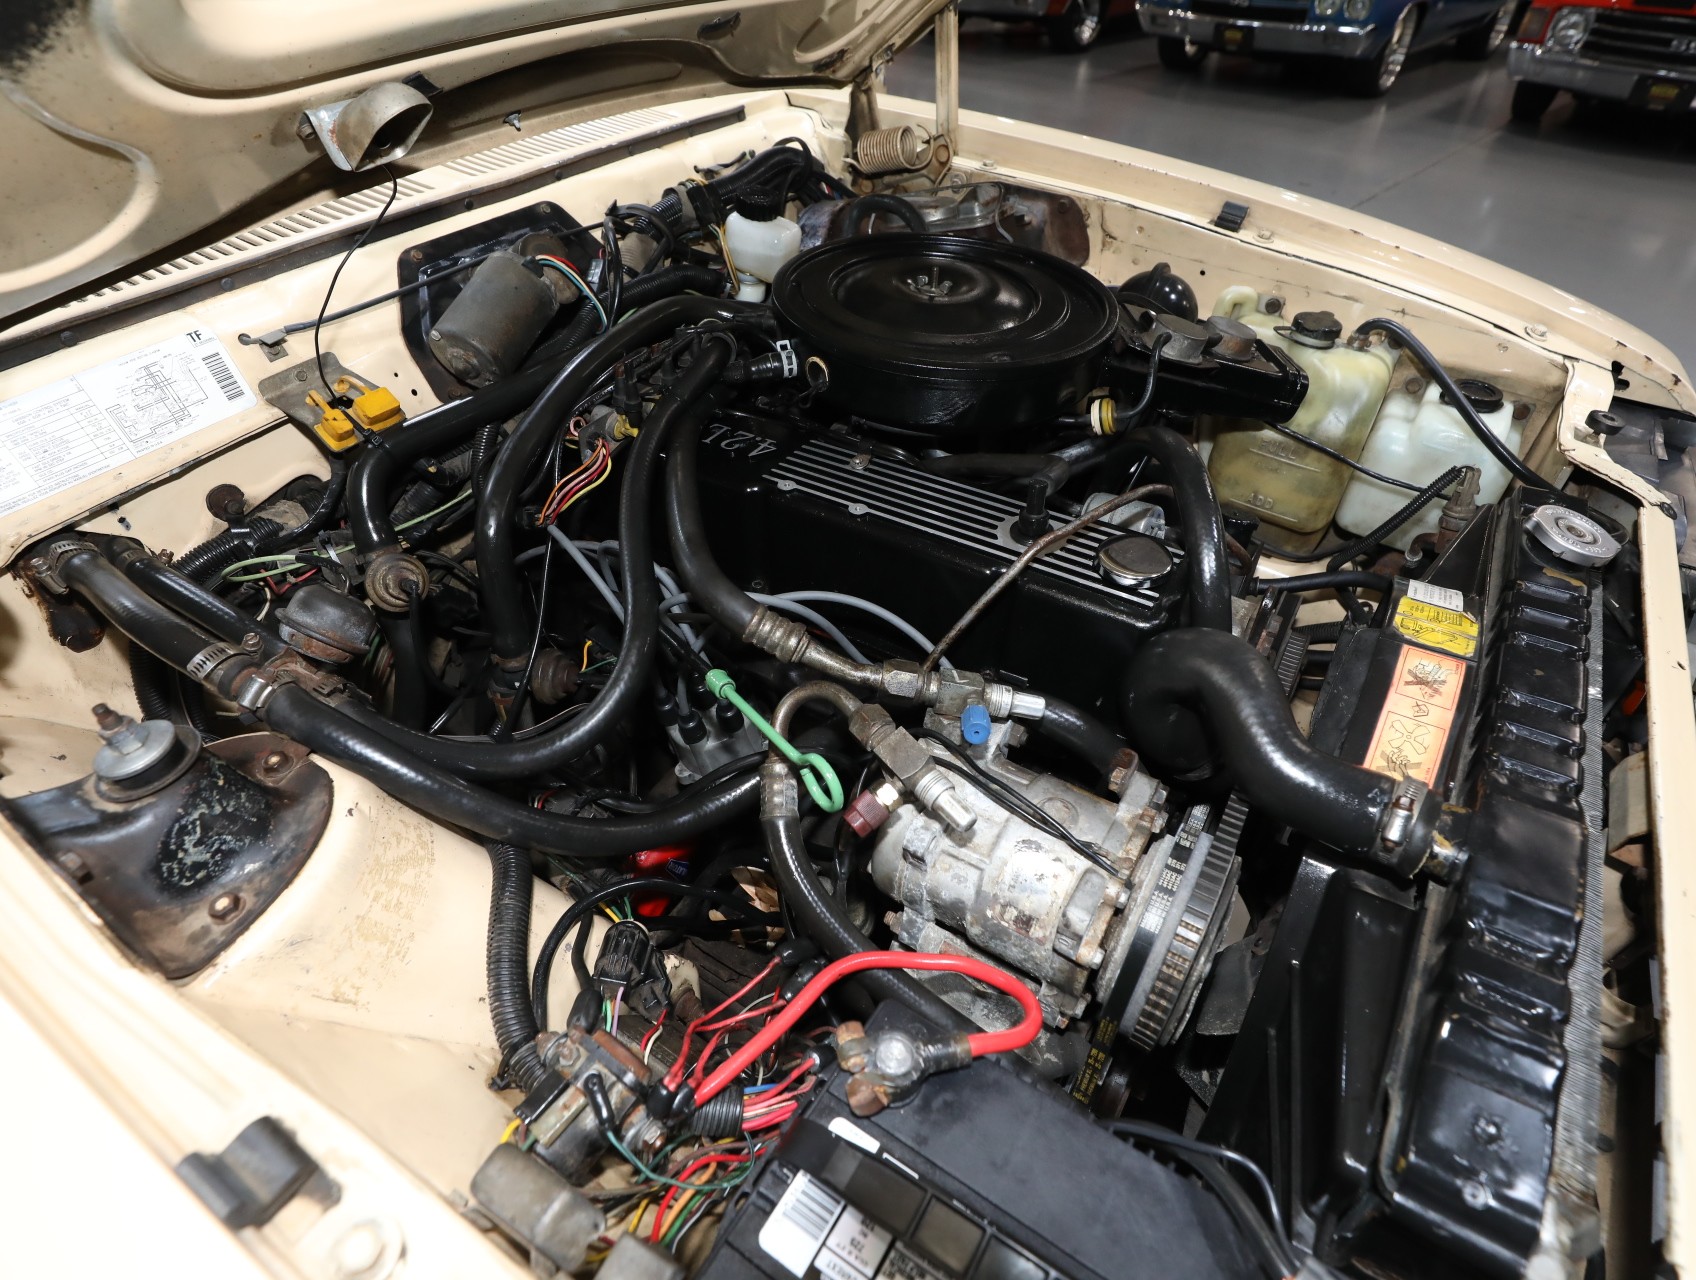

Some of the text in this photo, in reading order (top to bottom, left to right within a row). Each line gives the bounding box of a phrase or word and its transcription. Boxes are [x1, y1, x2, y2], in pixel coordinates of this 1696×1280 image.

[186, 330, 202, 342] TF
[702, 424, 776, 456] 4.2L
[1262, 440, 1296, 459] FULL
[1248, 492, 1274, 509] ADD
